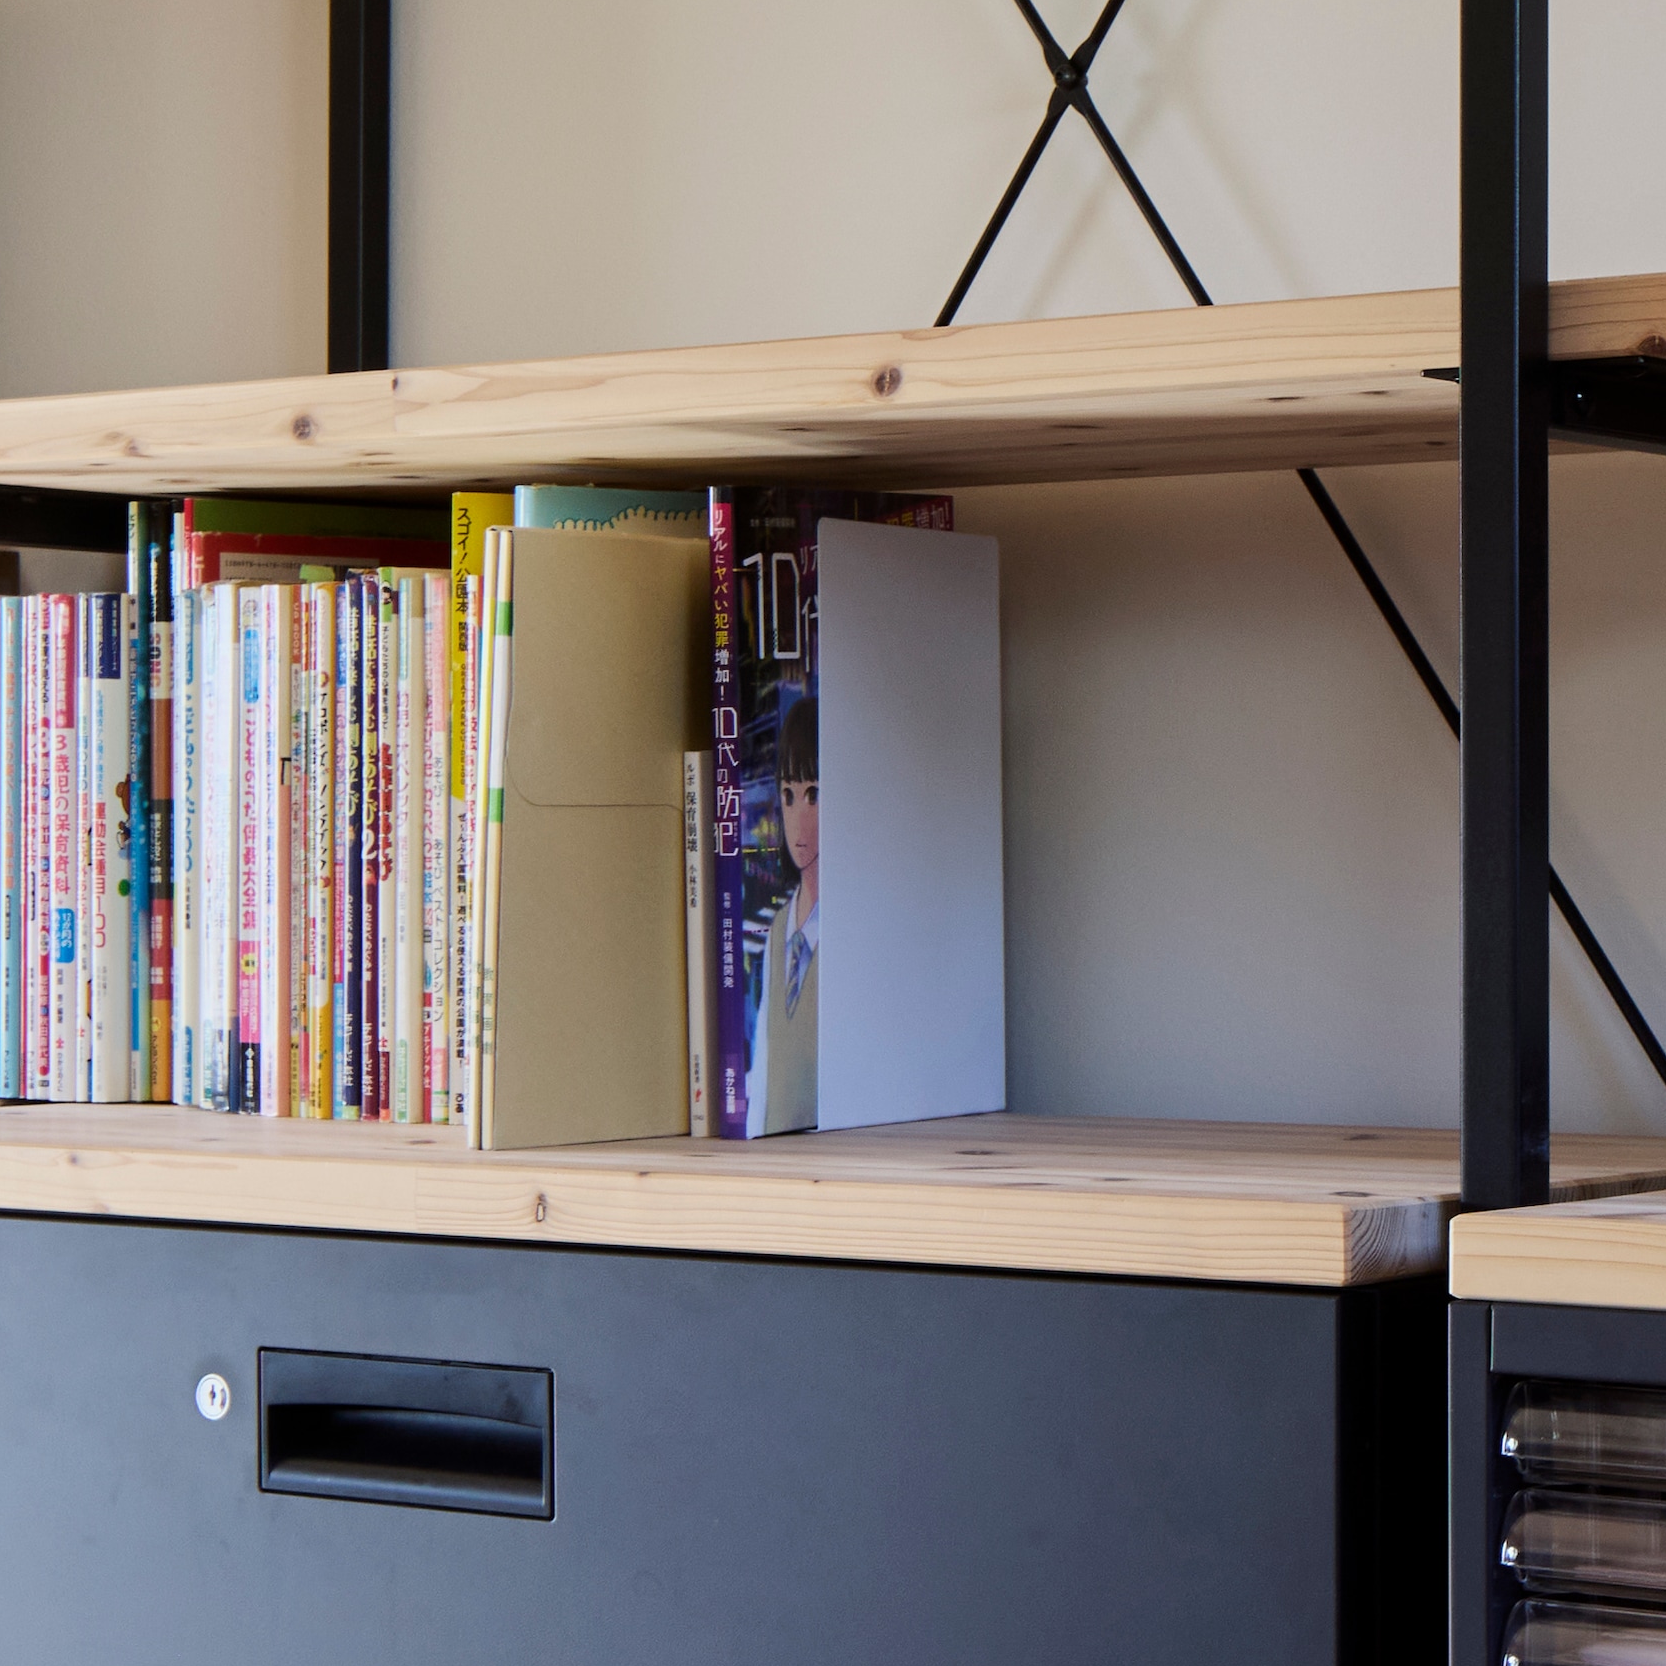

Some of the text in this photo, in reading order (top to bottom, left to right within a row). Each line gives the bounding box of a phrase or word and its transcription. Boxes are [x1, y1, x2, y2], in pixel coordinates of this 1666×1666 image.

[711, 508, 744, 857] リアルにヤバい犯罪増加! 10代の防犯
[54, 734, 72, 895] 3歳児の保育資料
[686, 791, 698, 852] 保育崩壊
